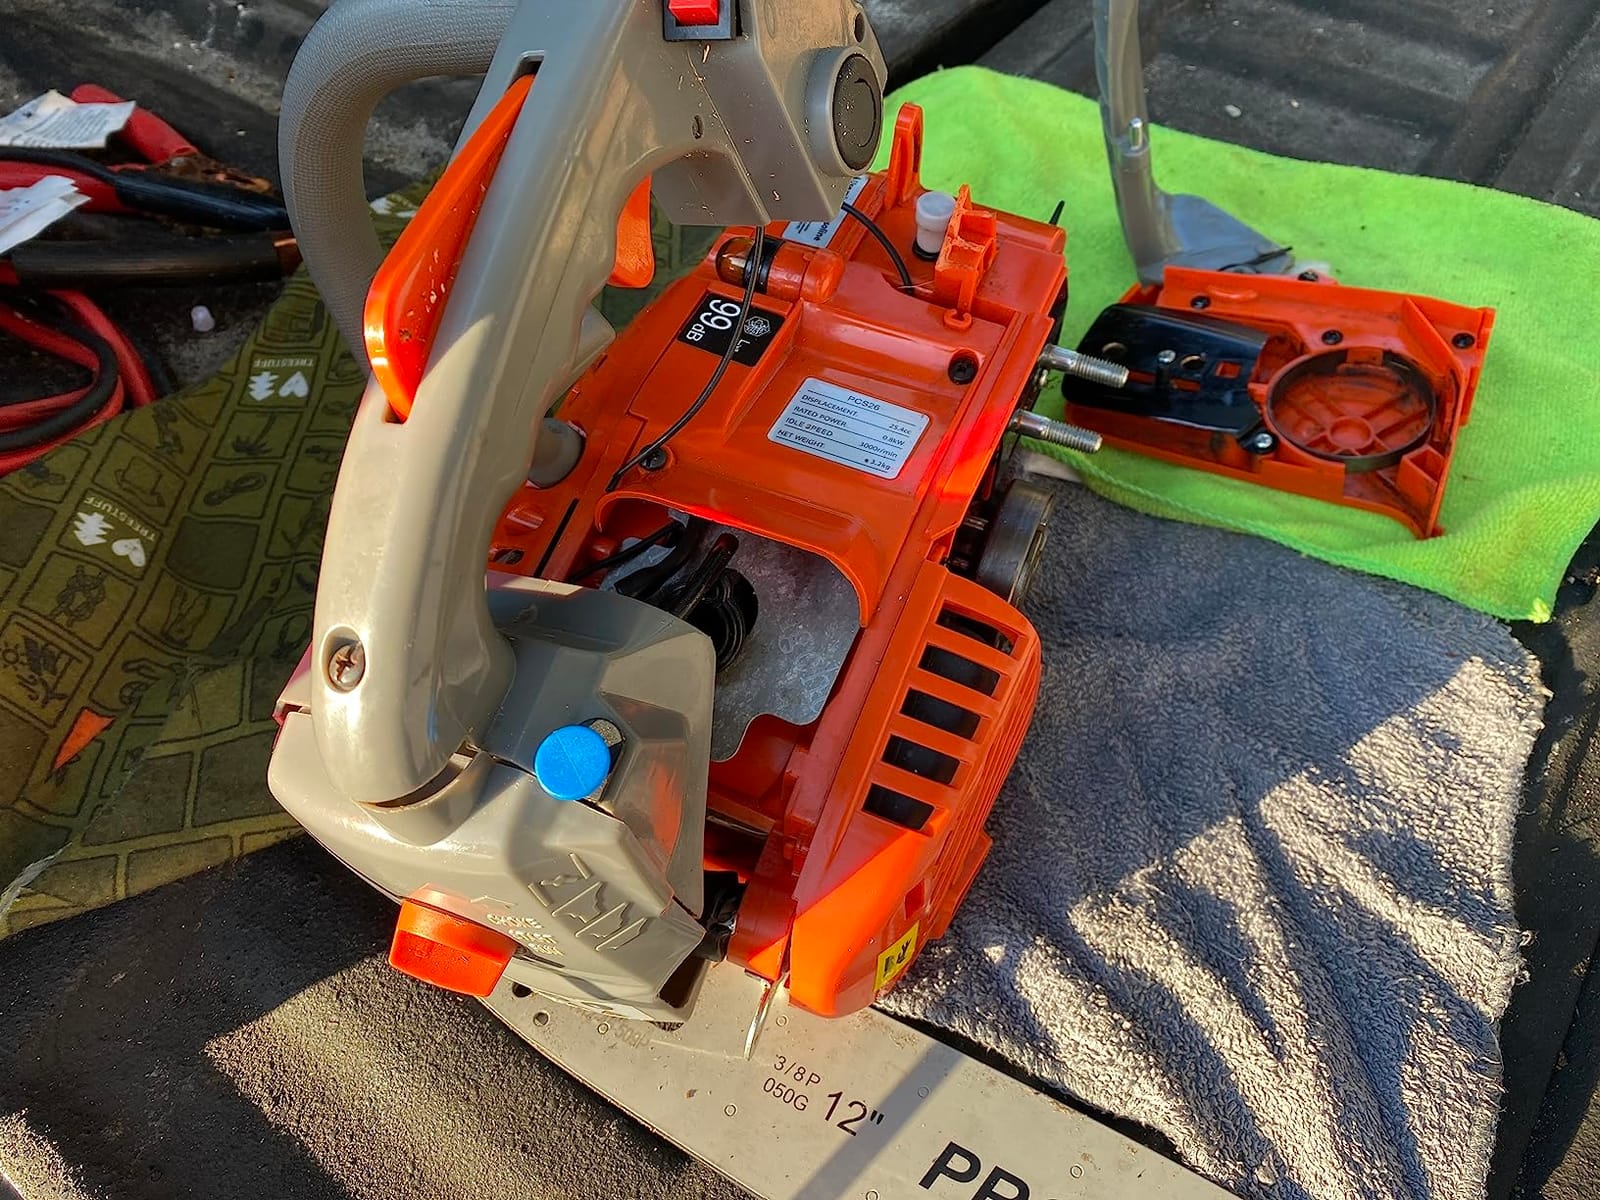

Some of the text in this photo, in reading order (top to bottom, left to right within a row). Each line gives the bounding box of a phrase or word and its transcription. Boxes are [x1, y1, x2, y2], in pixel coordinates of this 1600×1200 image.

[685, 299, 741, 342] 99 dB
[253, 358, 315, 368] TREESTUFF
[801, 394, 911, 435] DISPLACEMENT 25.4cc
[847, 395, 881, 411] PCS26
[785, 417, 898, 458] IDLE SPEED 3000r/min
[793, 405, 905, 446] RATED POWER 0.8kW
[777, 429, 891, 471] NET WEIGHT 3.2kg
[83, 496, 156, 542] TREESTUFF
[762, 1076, 810, 1113] 050G
[822, 1089, 886, 1138] 12"
[918, 1140, 1034, 1200] PR
